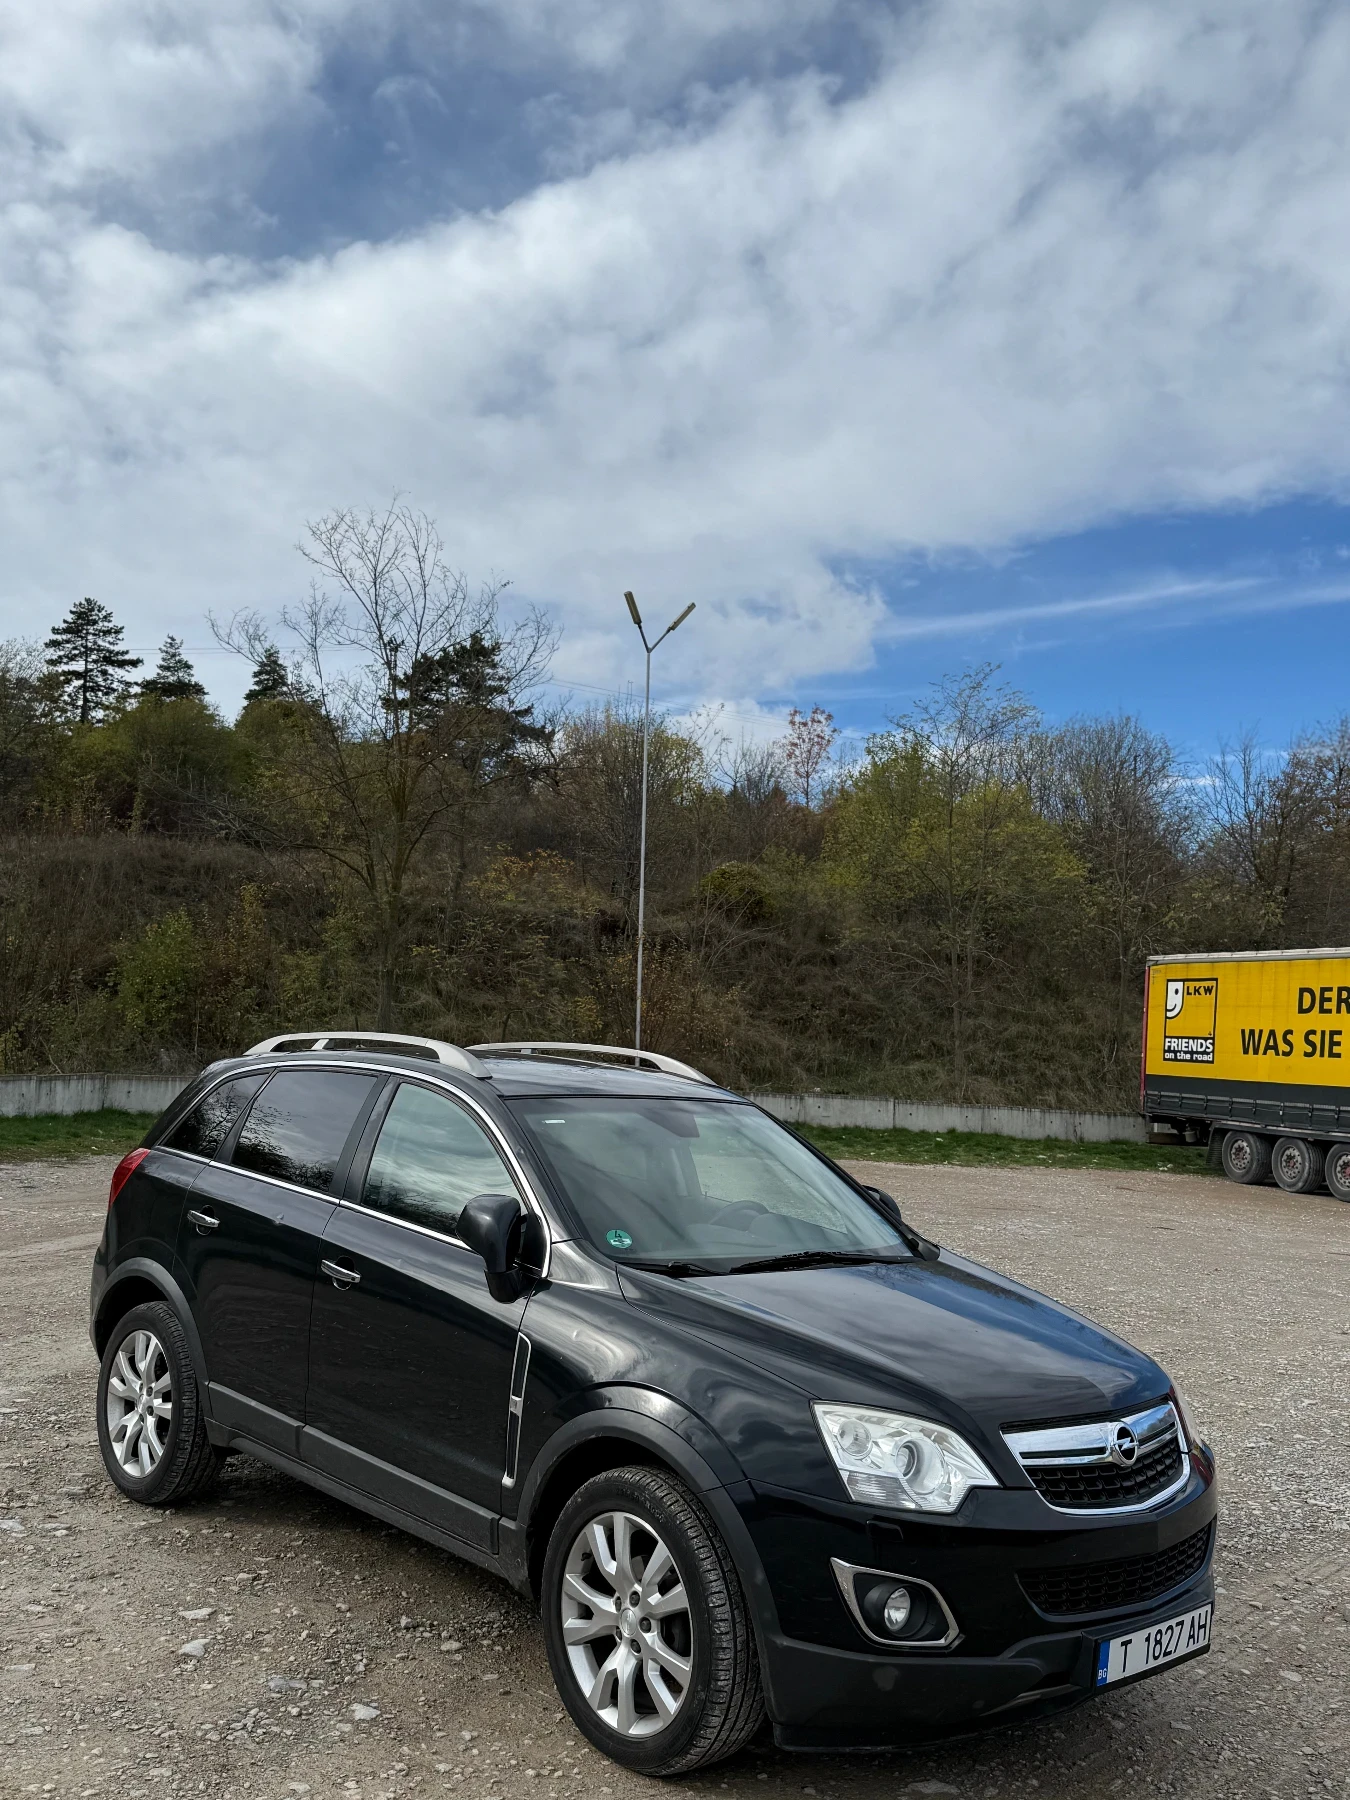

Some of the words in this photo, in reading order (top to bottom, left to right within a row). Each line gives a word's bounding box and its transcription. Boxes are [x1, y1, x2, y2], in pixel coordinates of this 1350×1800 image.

[1186, 985, 1214, 996] LKW
[1298, 986, 1350, 1014] DER
[1164, 1038, 1213, 1052] FRIENDS
[1241, 1029, 1294, 1057] WAS
[1303, 1029, 1343, 1059] SIE
[1177, 1052, 1191, 1060] the
[1193, 1053, 1213, 1061] road
[614, 1230, 622, 1238] 4
[1097, 1668, 1108, 1680] BG
[1121, 1639, 1132, 1672] T
[1145, 1620, 1185, 1664] 1827
[1186, 1610, 1208, 1648] AH
